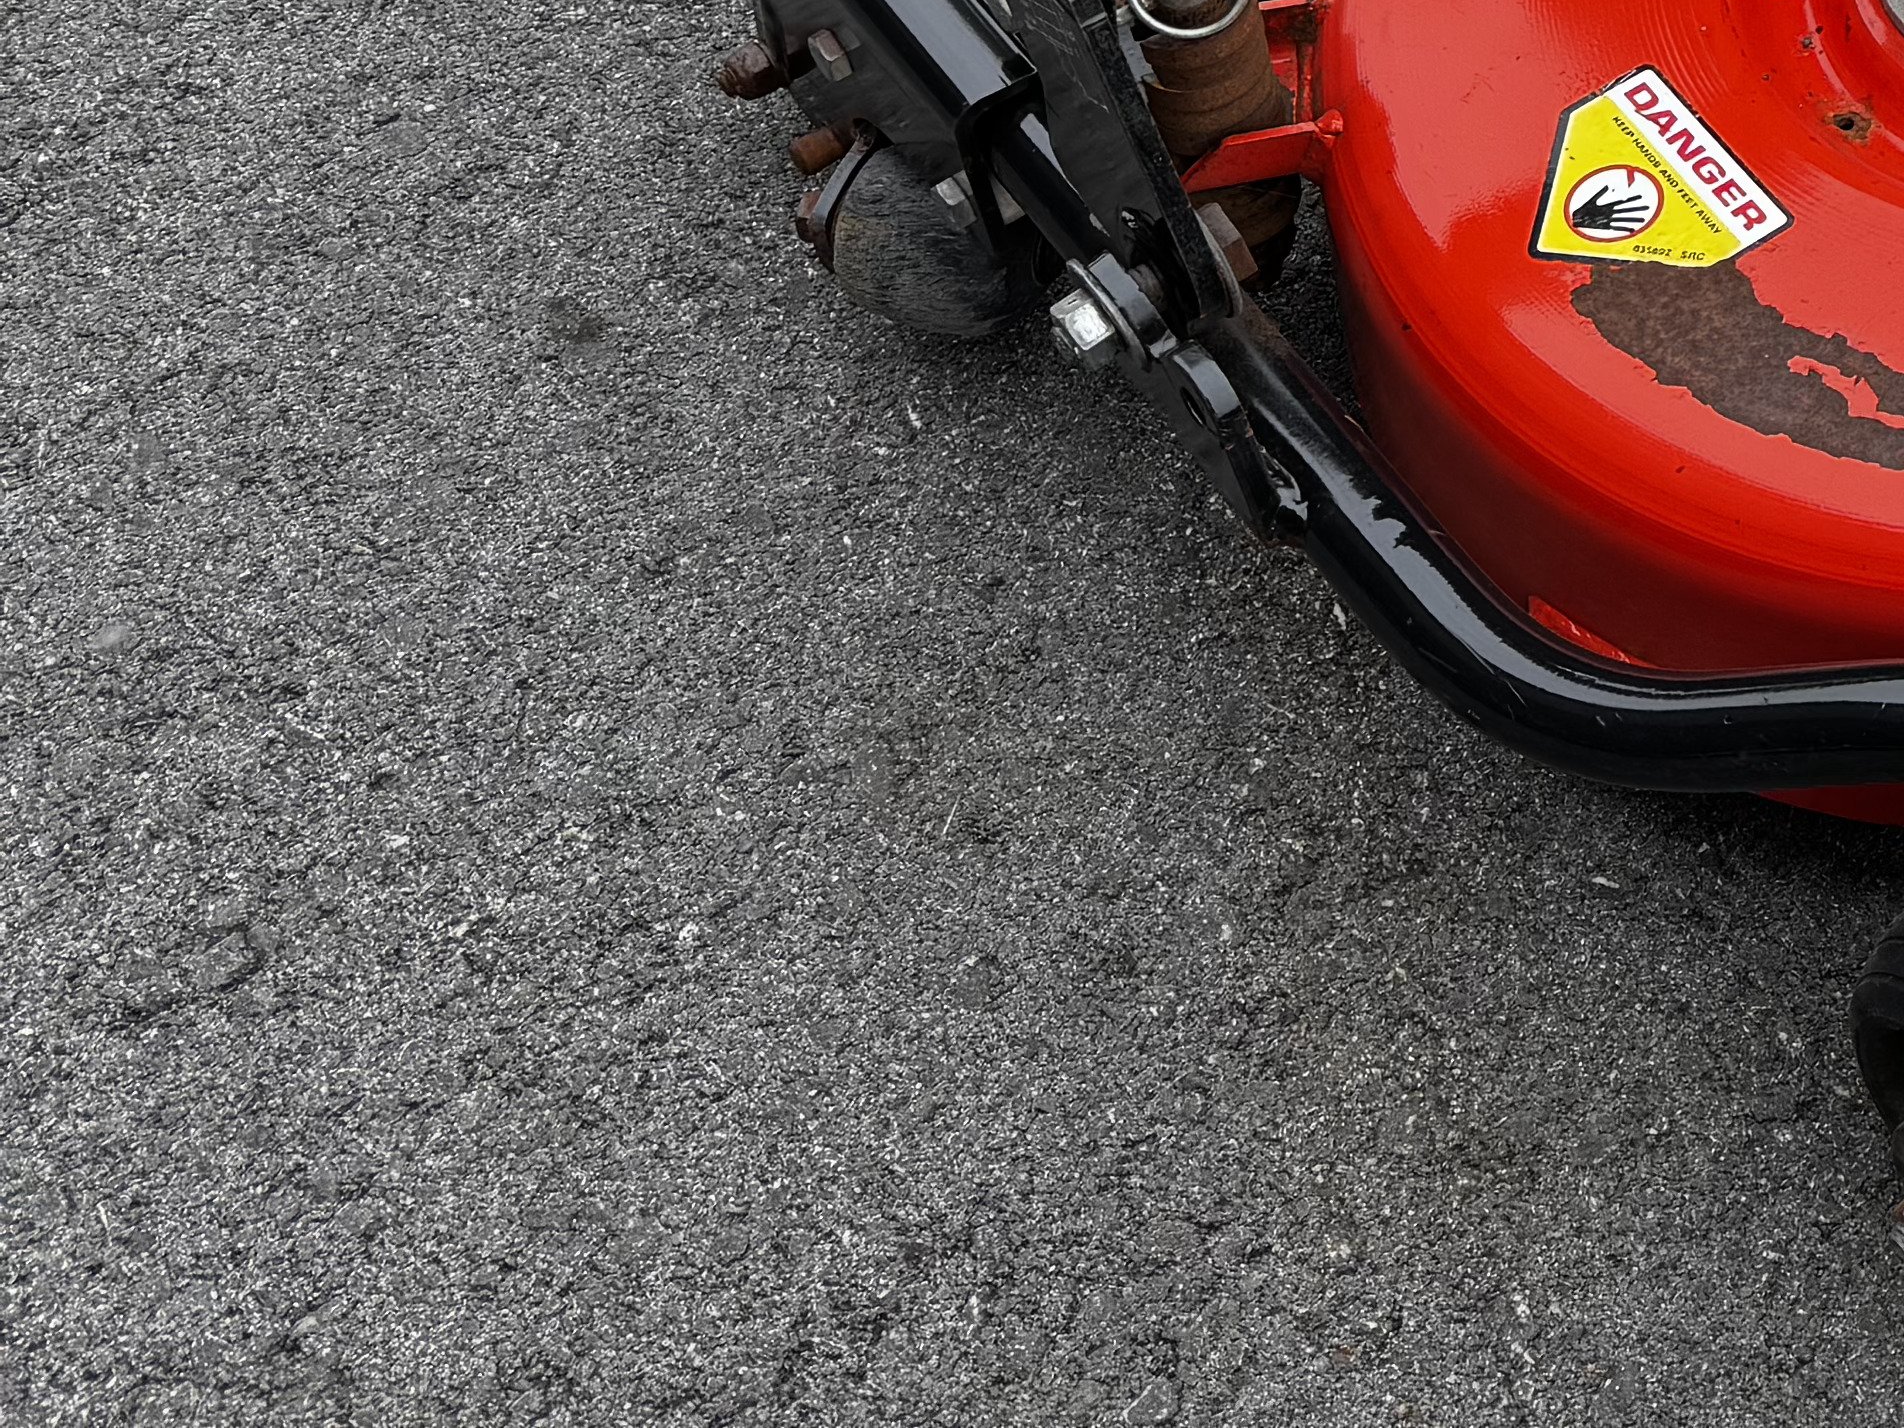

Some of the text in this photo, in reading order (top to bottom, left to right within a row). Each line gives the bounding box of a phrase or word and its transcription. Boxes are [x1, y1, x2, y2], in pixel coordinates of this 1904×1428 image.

[1613, 117, 1721, 233] KEEP HANDS AND FEET AWAY
[1624, 82, 1767, 231] DANGER
